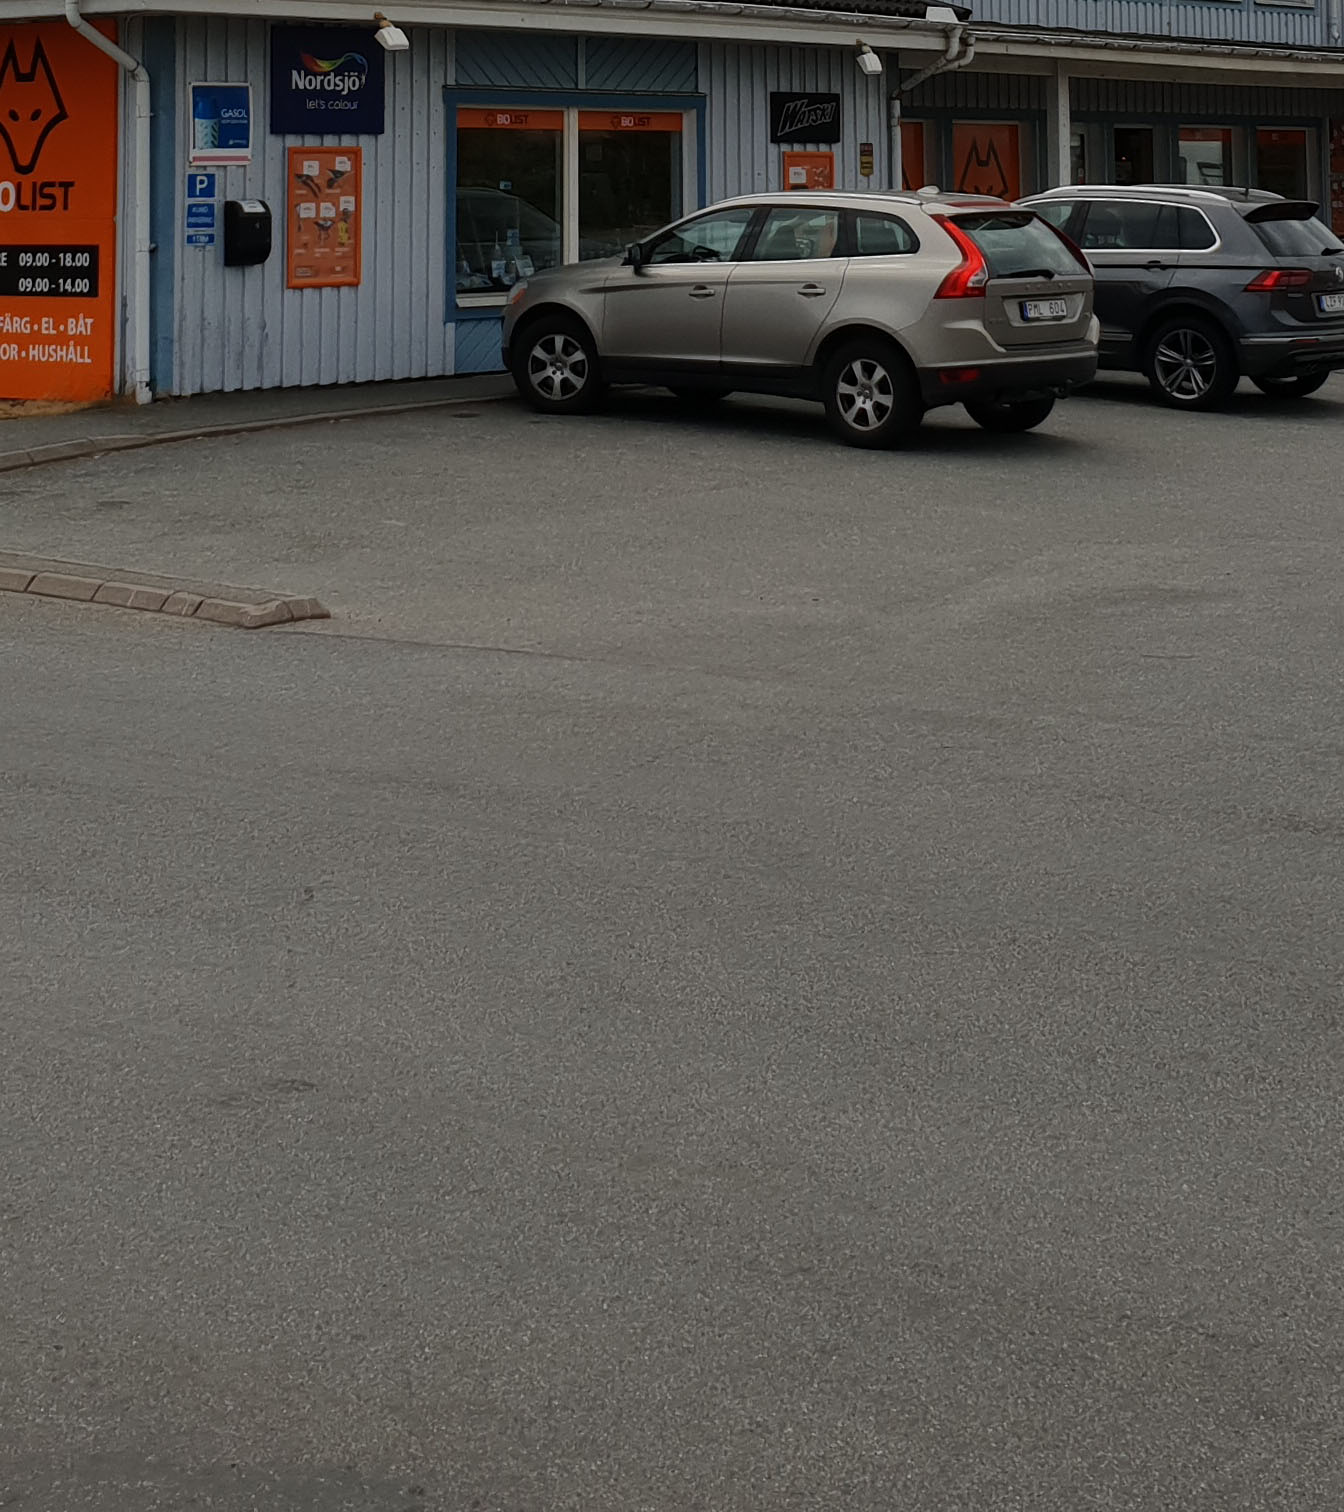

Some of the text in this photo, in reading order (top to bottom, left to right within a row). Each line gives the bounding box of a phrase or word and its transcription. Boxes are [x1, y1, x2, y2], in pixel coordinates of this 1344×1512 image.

[291, 70, 359, 95] Nordsjö
[306, 99, 359, 110] let's colour
[221, 108, 248, 118] GASOL
[496, 114, 528, 125] BOLIST
[620, 116, 651, 127] BOLIST
[196, 176, 208, 196] P
[18, 252, 49, 266] 09.00
[59, 252, 90, 266] 18.00
[18, 278, 49, 292] 09.00
[58, 278, 90, 293] 14.00
[41, 318, 57, 335] EL
[67, 313, 94, 336] BÅT
[29, 341, 92, 364] HUSHÅLL
